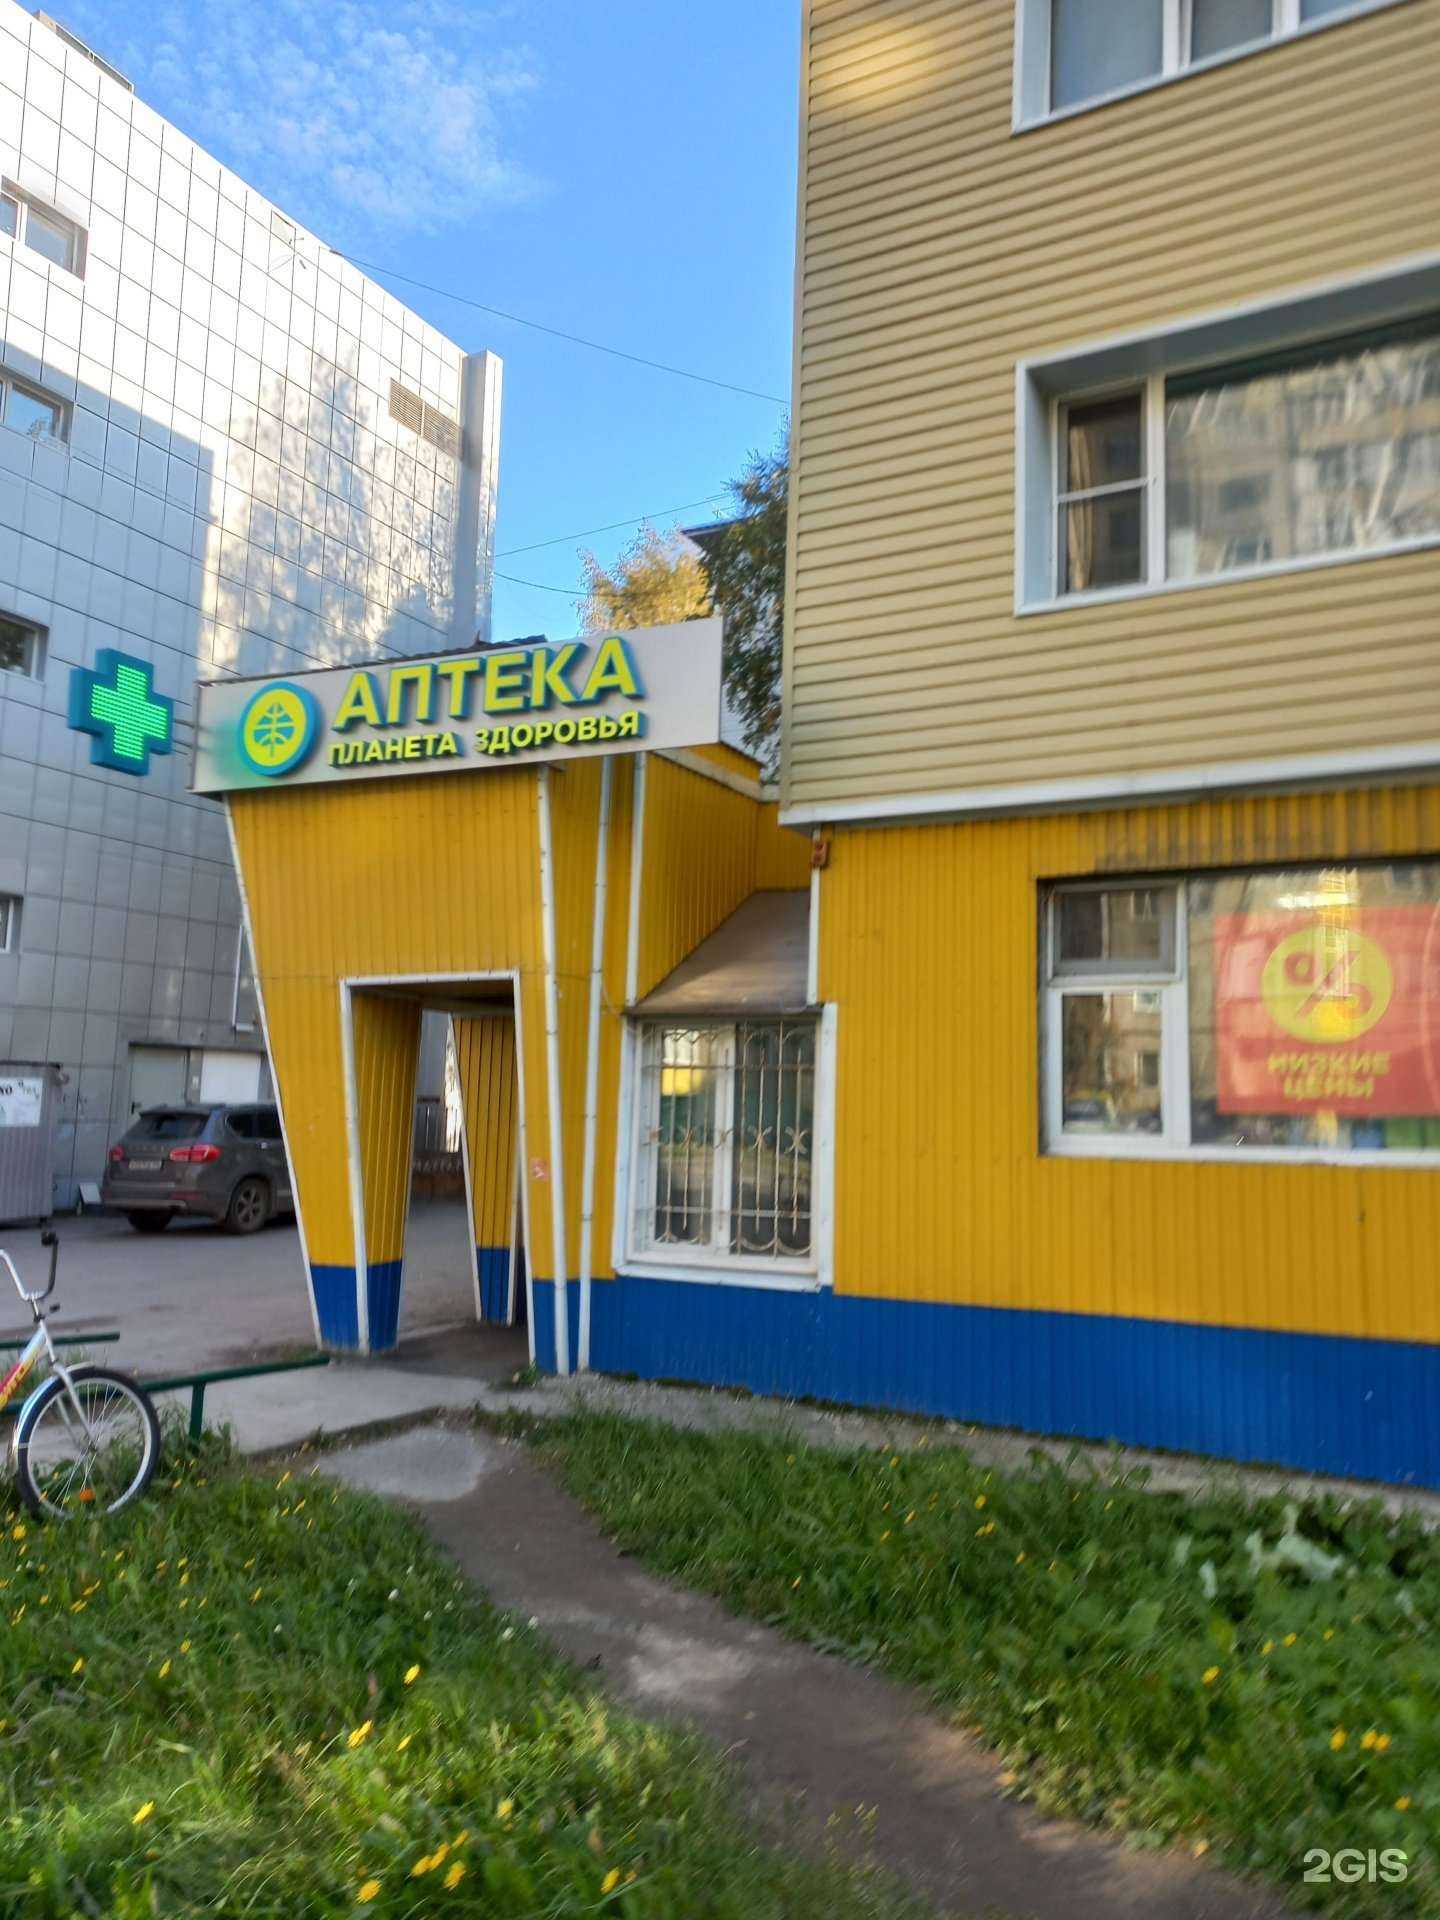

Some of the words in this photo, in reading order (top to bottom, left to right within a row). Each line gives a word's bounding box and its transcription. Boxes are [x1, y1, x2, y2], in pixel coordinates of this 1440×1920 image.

[331, 636, 643, 732] АПТЕКА
[328, 731, 462, 767] ПЛАНЕТА
[475, 711, 644, 755] ЗДОРОВЬЯ
[1283, 1076, 1375, 1101] ЦЕНЫ
